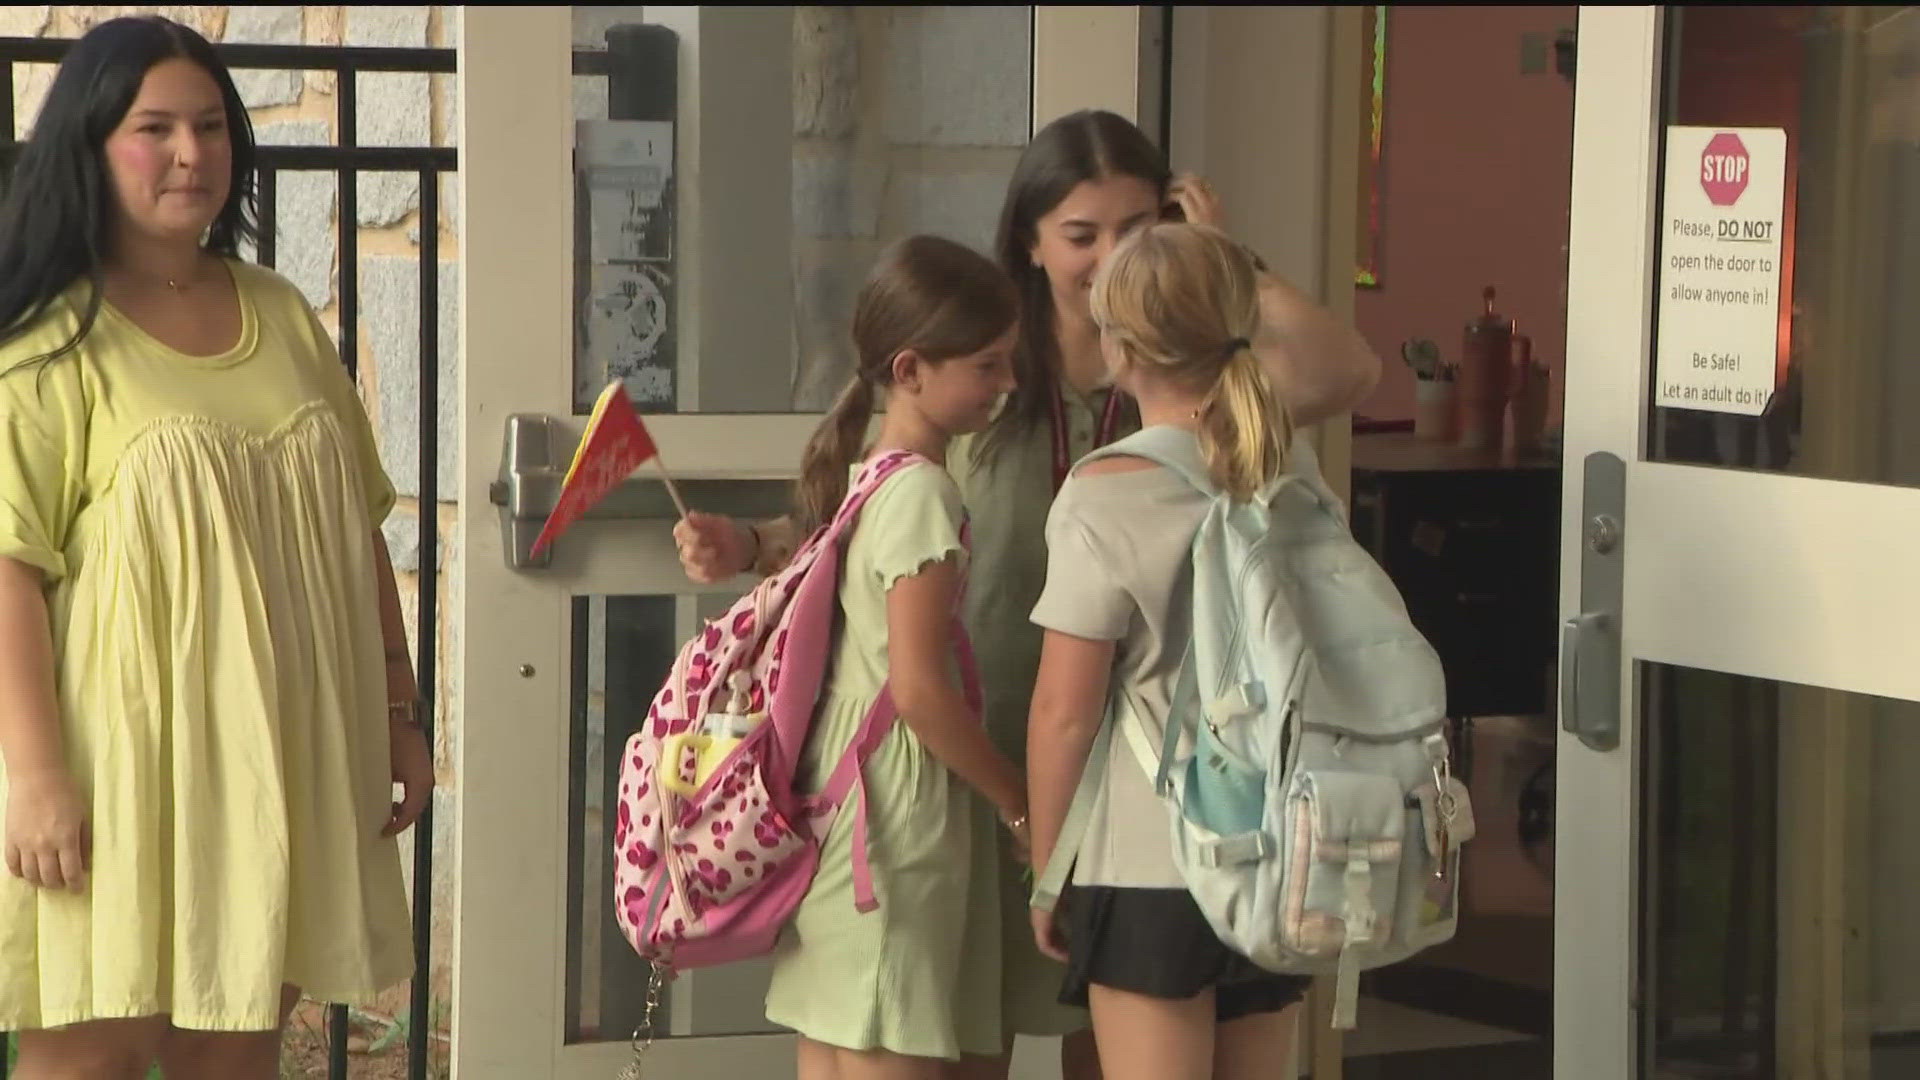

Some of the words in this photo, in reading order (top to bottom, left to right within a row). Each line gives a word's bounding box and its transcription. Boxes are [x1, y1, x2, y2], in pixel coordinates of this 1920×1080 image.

[1703, 155, 1747, 183] STOP
[1673, 219, 1714, 238] Please,
[1718, 220, 1740, 237] DO
[1743, 221, 1773, 238] NOT
[1671, 255, 1700, 272] open
[1704, 254, 1724, 270] the
[1727, 255, 1755, 272] door
[1760, 257, 1772, 272] to
[1671, 283, 1702, 300] allow
[1705, 288, 1749, 307] anyone
[1753, 287, 1768, 305] in!
[1692, 352, 1708, 368] Be
[1711, 353, 1740, 371] Safe!
[1663, 381, 1680, 398] Let
[1684, 386, 1698, 400] an
[1702, 385, 1732, 402] adult
[1735, 387, 1752, 404] do
